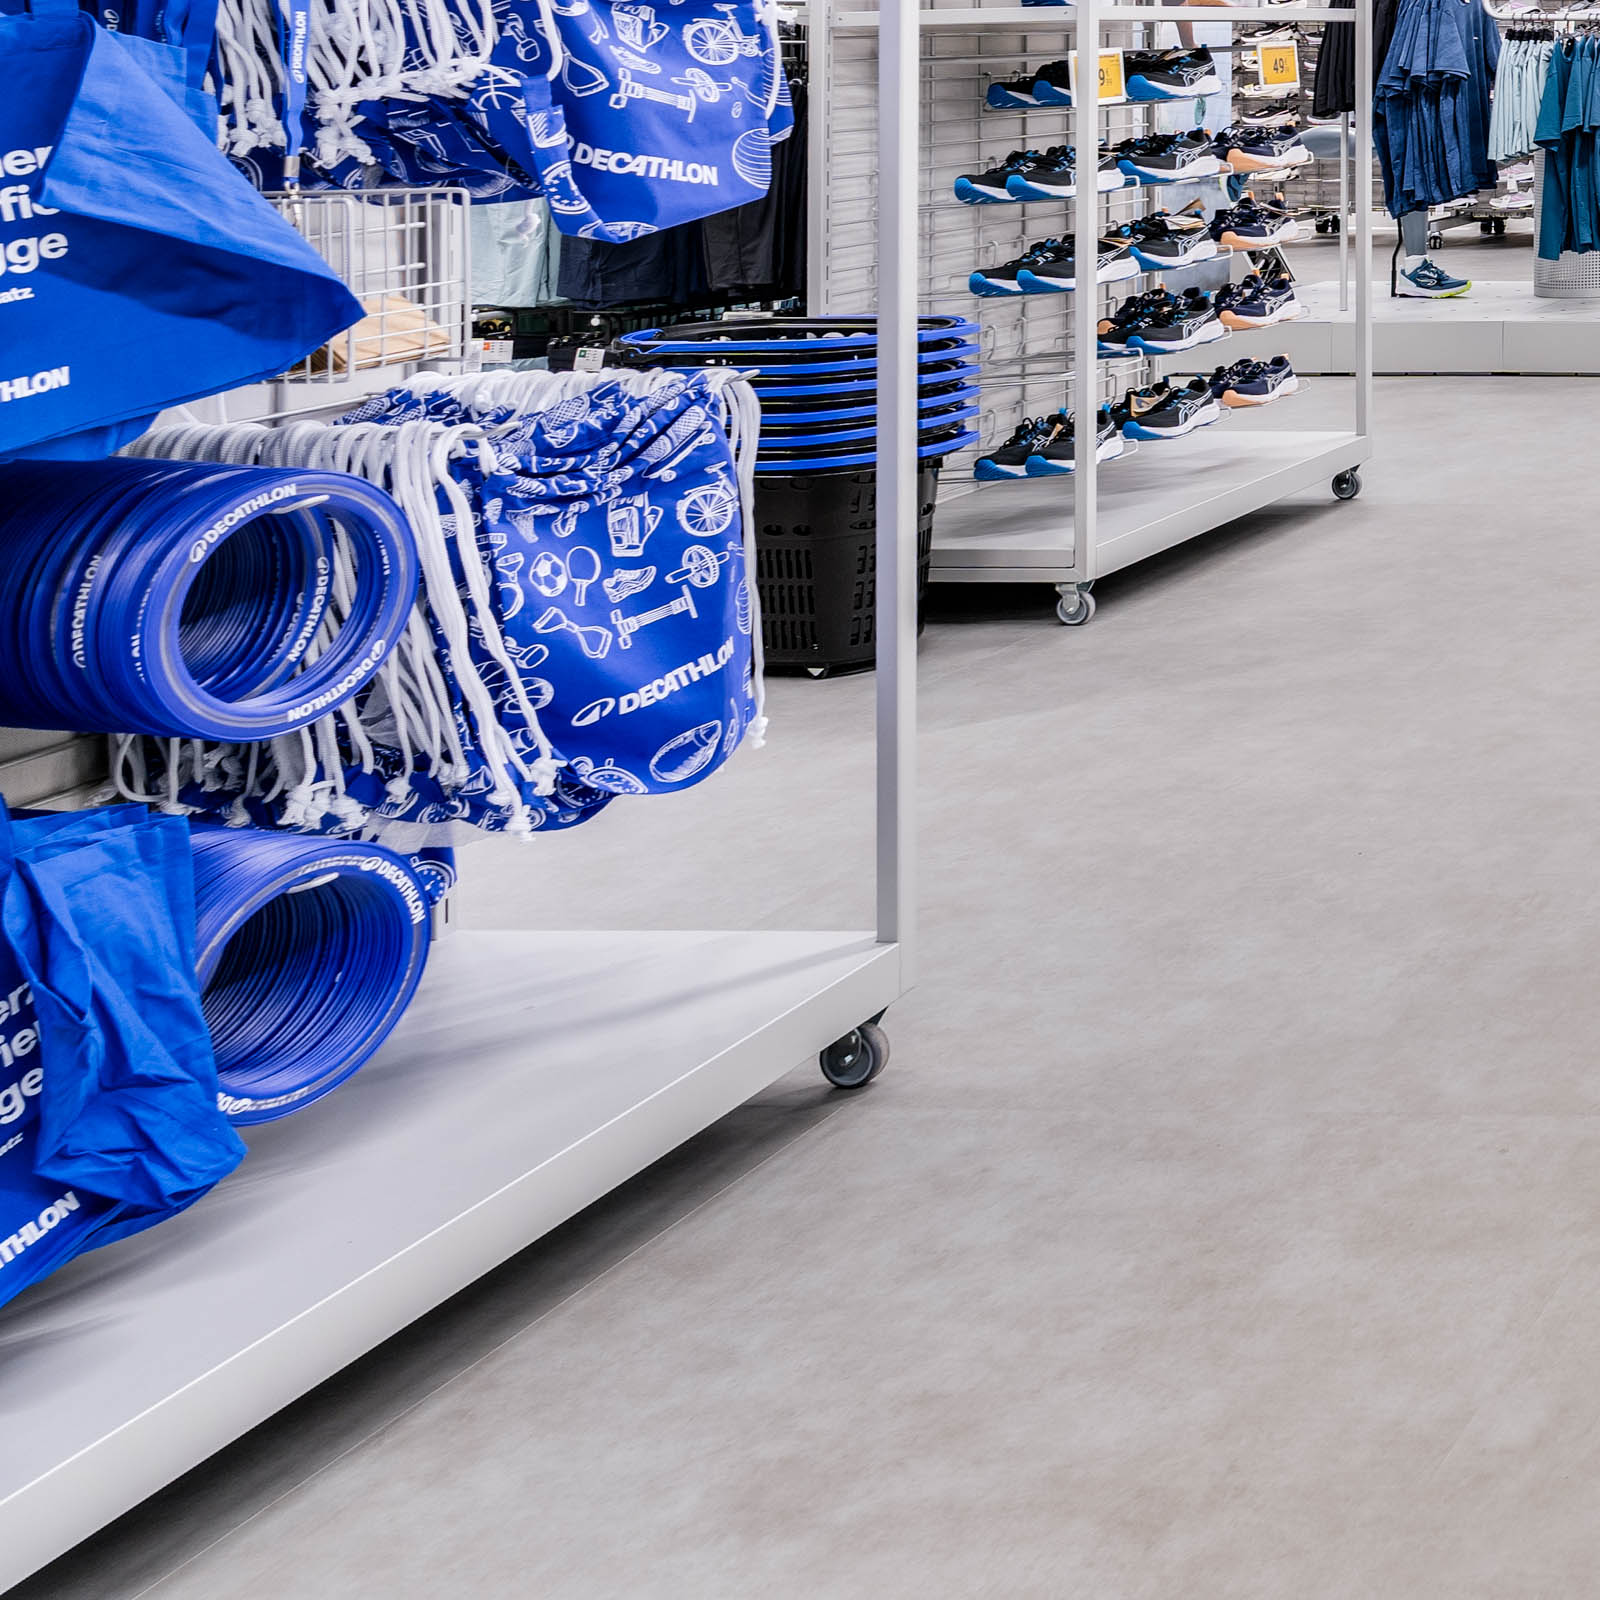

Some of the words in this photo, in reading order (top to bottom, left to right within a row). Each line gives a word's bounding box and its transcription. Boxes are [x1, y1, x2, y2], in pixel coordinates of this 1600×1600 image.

[293, 11, 306, 70] DECATHLON
[574, 142, 719, 186] DECATHLON
[206, 483, 297, 544] DECATHLON
[287, 576, 331, 663] DECATHLON
[287, 655, 374, 722] DECATHLON
[617, 637, 736, 718] DECATHLON
[377, 862, 425, 925] DECATHLON
